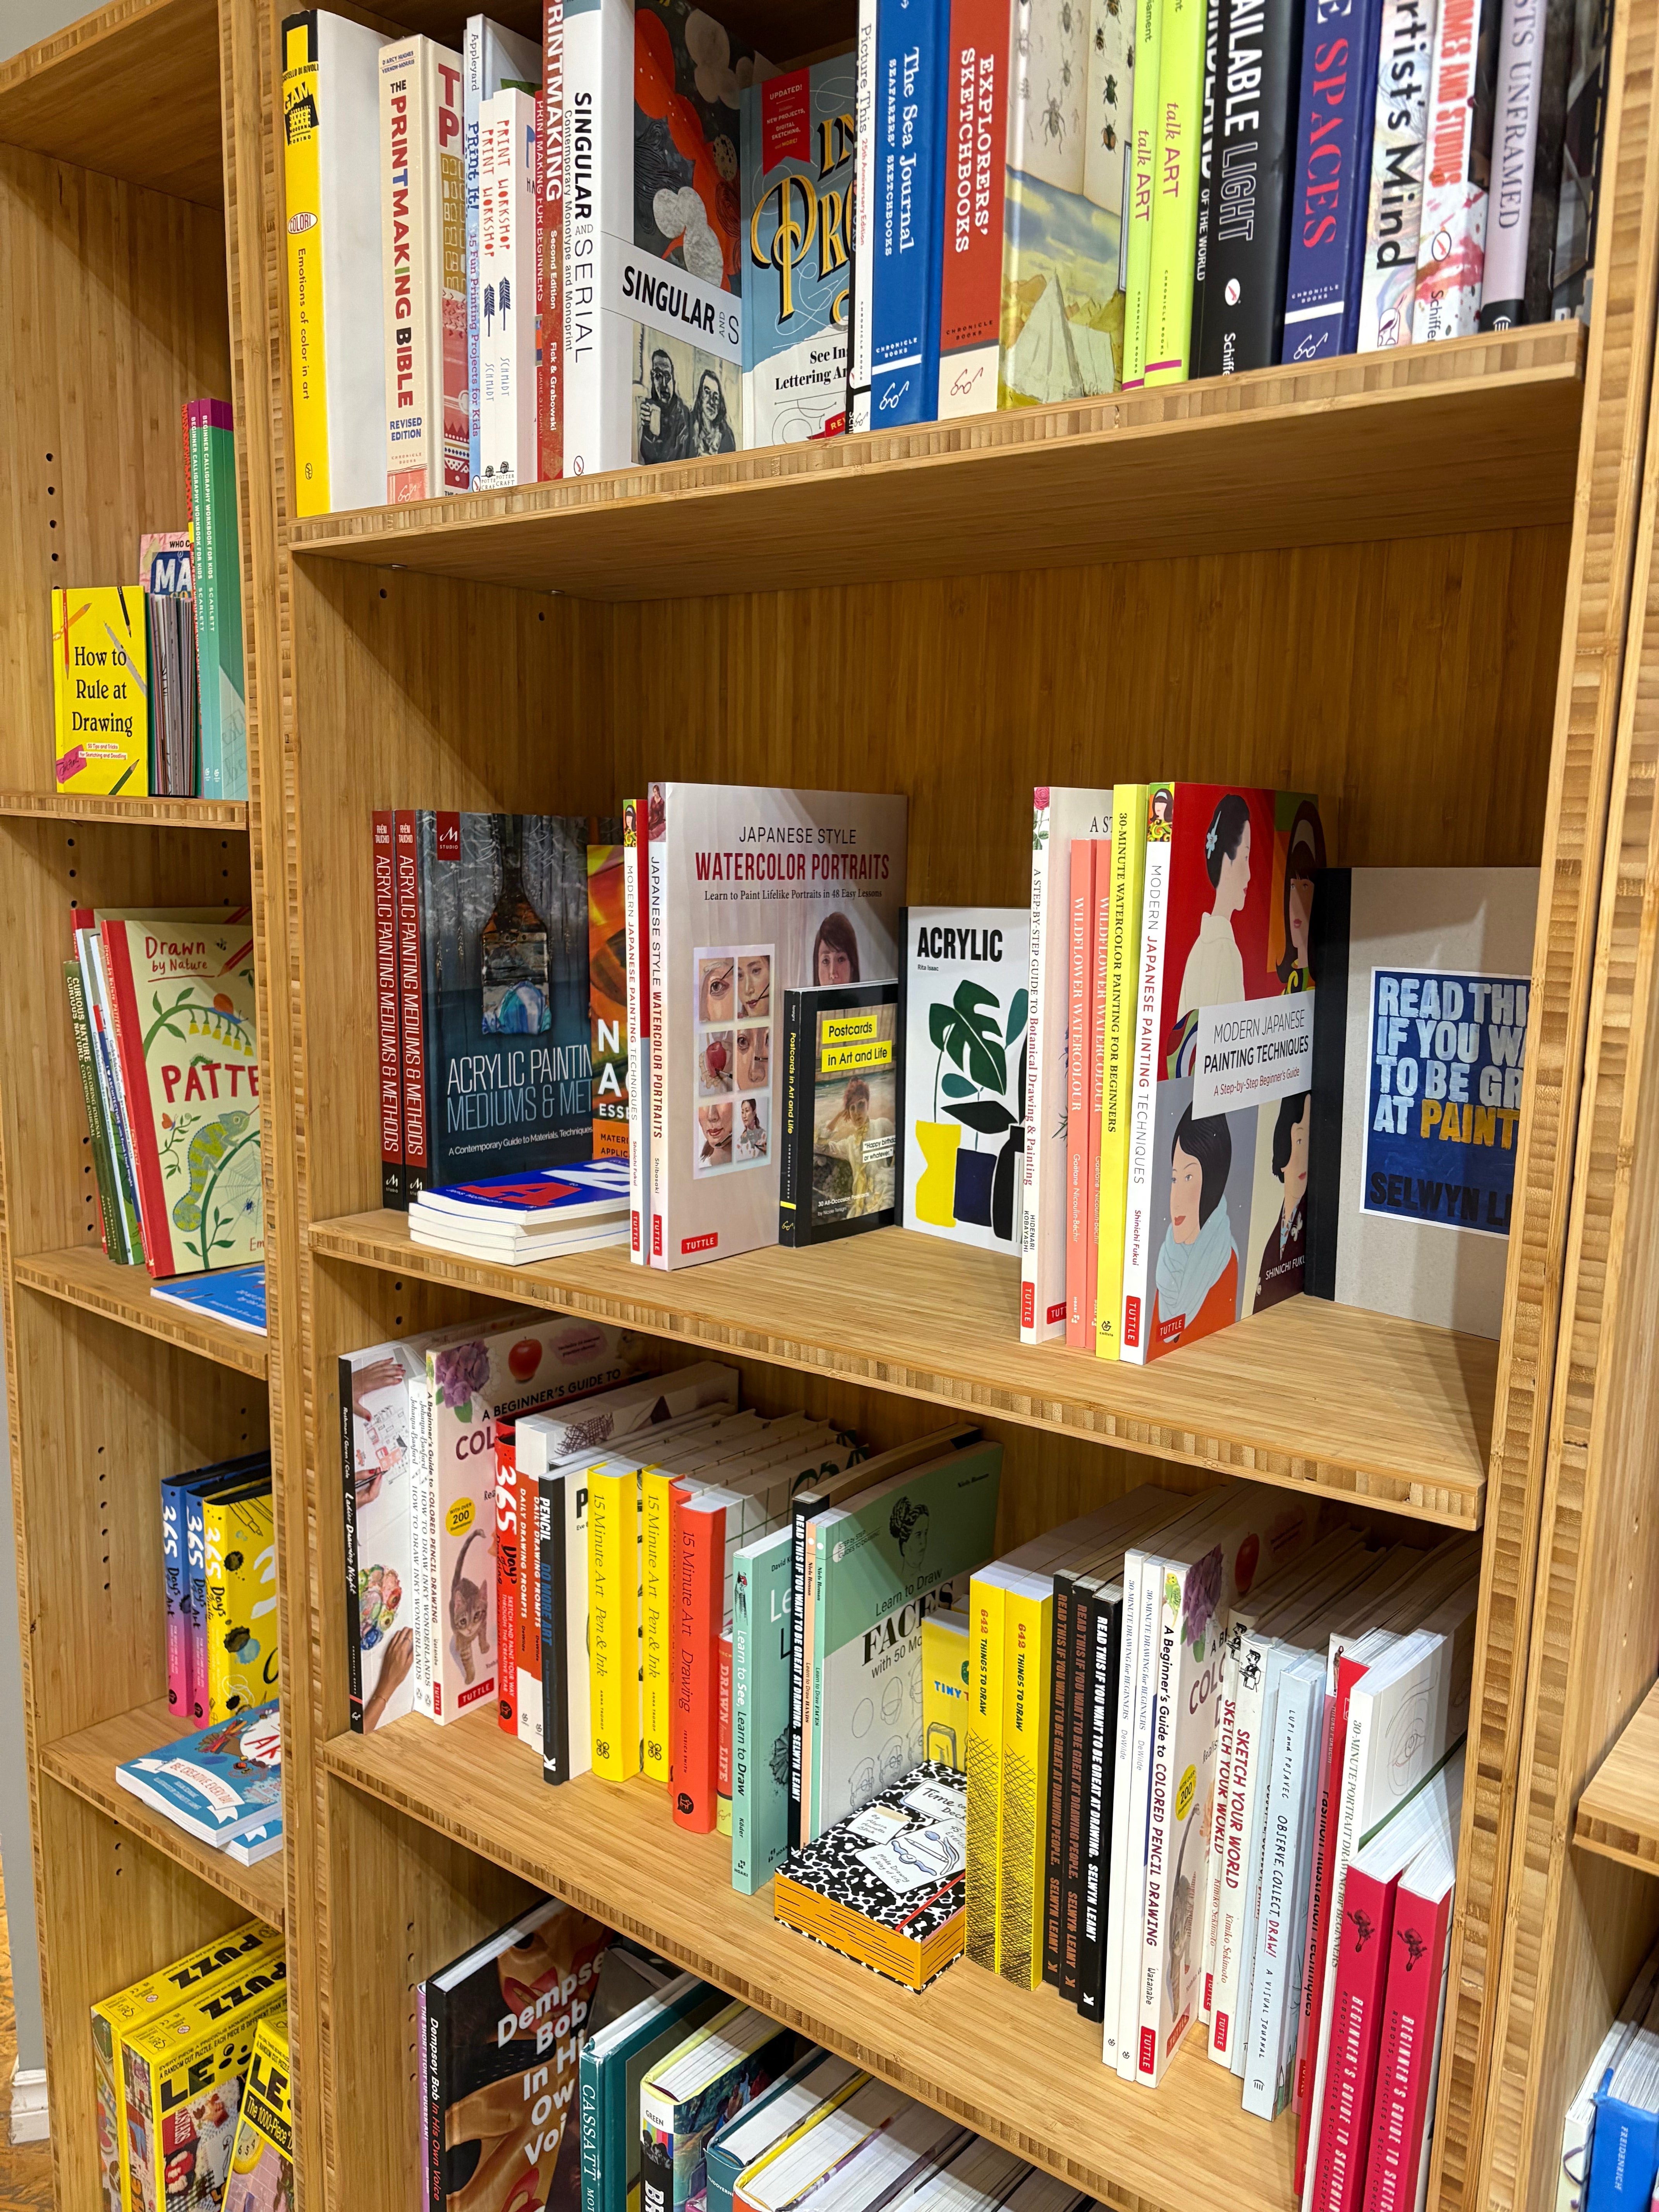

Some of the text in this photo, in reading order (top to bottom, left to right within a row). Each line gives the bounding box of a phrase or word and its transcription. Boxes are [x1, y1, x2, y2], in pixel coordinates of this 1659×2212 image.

[471, 33, 479, 92] Appleyard
[769, 84, 803, 100] UPDATED!
[899, 47, 919, 254] The Sea Journal
[955, 47, 975, 253] SKETCHBOOKS
[975, 54, 994, 236] EXPLORERS'
[1163, 102, 1181, 198] talk ART
[1304, 38, 1349, 248] SPACES
[1499, 60, 1533, 229] UNFRAMED
[1218, 141, 1258, 241] LIGHT
[1376, 142, 1424, 270] Mind
[290, 215, 311, 232] COLORI
[390, 79, 413, 408] THE PRINTMAKING BIBLE
[574, 92, 594, 363] SINGULAR AND SERIAL
[301, 311, 308, 324] of
[622, 265, 715, 335] SINGULAR
[301, 329, 309, 361] color
[946, 320, 994, 335] CHRONICLE
[956, 330, 982, 340] BOOKS
[302, 366, 309, 377] in
[74, 646, 127, 667] How to
[76, 679, 127, 700] Rule at
[71, 711, 133, 738] Drawing
[739, 826, 857, 845] JAPANESE STYLE
[695, 852, 890, 881] WATERCOLOR PORTRAITS
[1034, 868, 1041, 876] A
[704, 889, 882, 901] Learn to Paint Lifelike Portraits in 48 Easy Lessons
[1032, 879, 1041, 957] STEP-BY-STEP
[145, 937, 205, 959] Drawn
[152, 959, 208, 973] by Nature
[916, 927, 1003, 962] ACRYLIC
[1031, 960, 1039, 995] GUIDE
[1108, 812, 1127, 1133] 30-MINUTE WATERCOLOR PAINTING FOR BEGINNERS
[399, 855, 423, 1156] ACRYLIC PAINTING MEDIUMS & METHODS
[1030, 998, 1038, 1014] TO
[1377, 976, 1464, 1020] READ
[828, 1022, 873, 1037] Postcards
[1029, 1018, 1039, 1070] Botanical
[1214, 1009, 1305, 1045] MODERN JAPANESE
[1377, 1017, 1482, 1065] IF YOU
[447, 1051, 525, 1096] ACRYLIC
[828, 1047, 888, 1066] in Art and Life
[1204, 1034, 1309, 1074] PAINTING TECHNIQUES
[1025, 1073, 1037, 1122] Drawing
[1214, 1067, 1300, 1096] A Step-by-Step Beginner's Guide
[1376, 1055, 1470, 1104] TO BE
[448, 1085, 537, 1133] MEDIUMS
[1372, 1094, 1415, 1135] AT
[448, 1126, 593, 1156] A Contemporary Guide to Materials, Techniques
[1024, 1135, 1036, 1186] Painting
[1370, 1171, 1480, 1221] SELWYN
[686, 1237, 714, 1251] TUTTLE
[679, 1530, 695, 1713] 15 Minute Art Drawing
[1016, 1623, 1026, 1732] 642 THINGS TO DRAW
[736, 1629, 747, 1796] Learn to See, Learn to Draw
[1089, 1616, 1108, 1858] READ THIS IF YOU WANT TO BE GREAT AT DRAWING.
[1146, 1625, 1174, 1947] A Beginner's Guide to COLORED PENCIL DRAWING
[1225, 1728, 1251, 1889] SKETCH YOUR WORLD
[1265, 1814, 1288, 1958] OBSERVE, COLLECT, DRAW!
[168, 1934, 264, 1990] PUZZ
[1221, 1913, 1234, 1984] Kimiko Sekimoto
[160, 2053, 215, 2113] LE
[582, 2083, 596, 2181] CASSATT
[645, 2109, 664, 2126] GREEN
